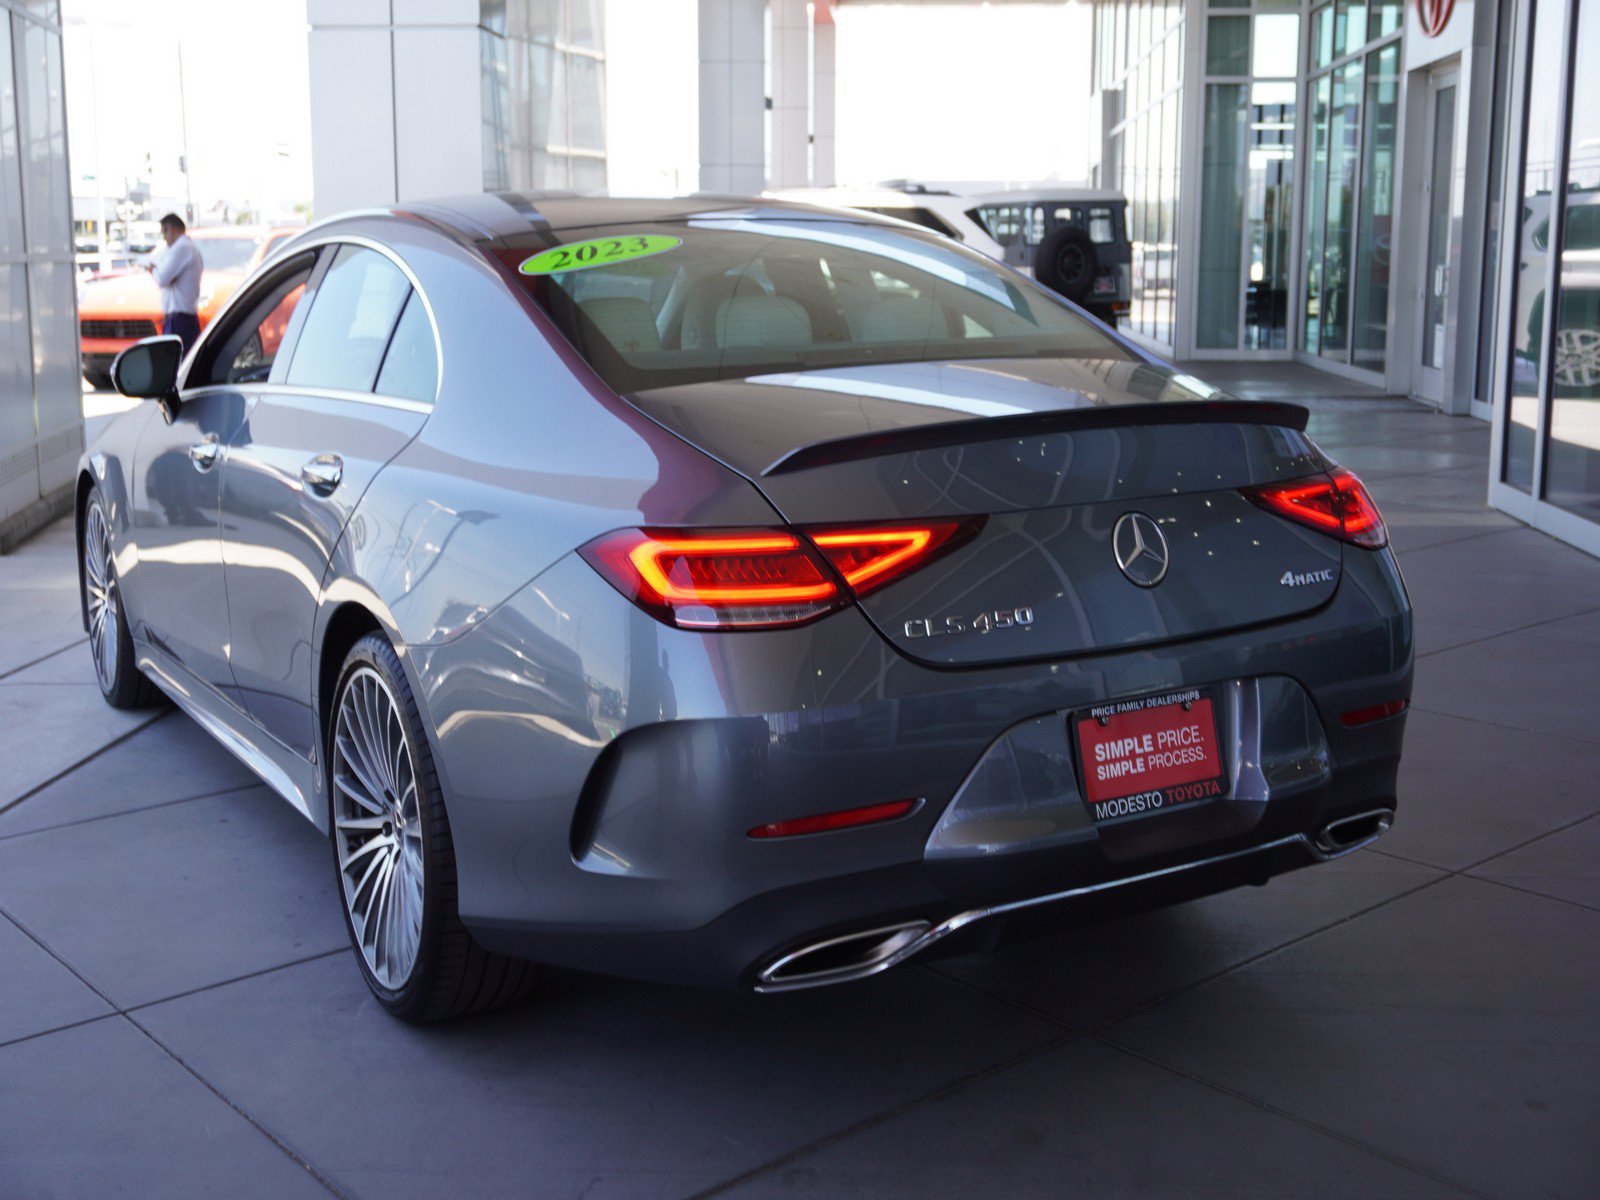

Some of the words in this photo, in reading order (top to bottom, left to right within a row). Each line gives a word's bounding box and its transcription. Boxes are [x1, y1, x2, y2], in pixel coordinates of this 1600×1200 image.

[550, 236, 650, 269] 2023
[1280, 568, 1334, 588] 4MATIC
[904, 615, 966, 638] CLS
[972, 607, 1034, 631] 450
[1091, 705, 1115, 718] PRICE
[1117, 700, 1145, 713] FAMILY
[1147, 690, 1200, 707] DEALERSHIPS
[1094, 734, 1154, 762] SIMPLE
[1157, 725, 1204, 750] PRICE.
[1097, 758, 1146, 781] SIMPLE
[1148, 746, 1207, 770] PROCESS.
[1095, 791, 1163, 819] MODESTO
[1166, 781, 1221, 803] TOYOTA
